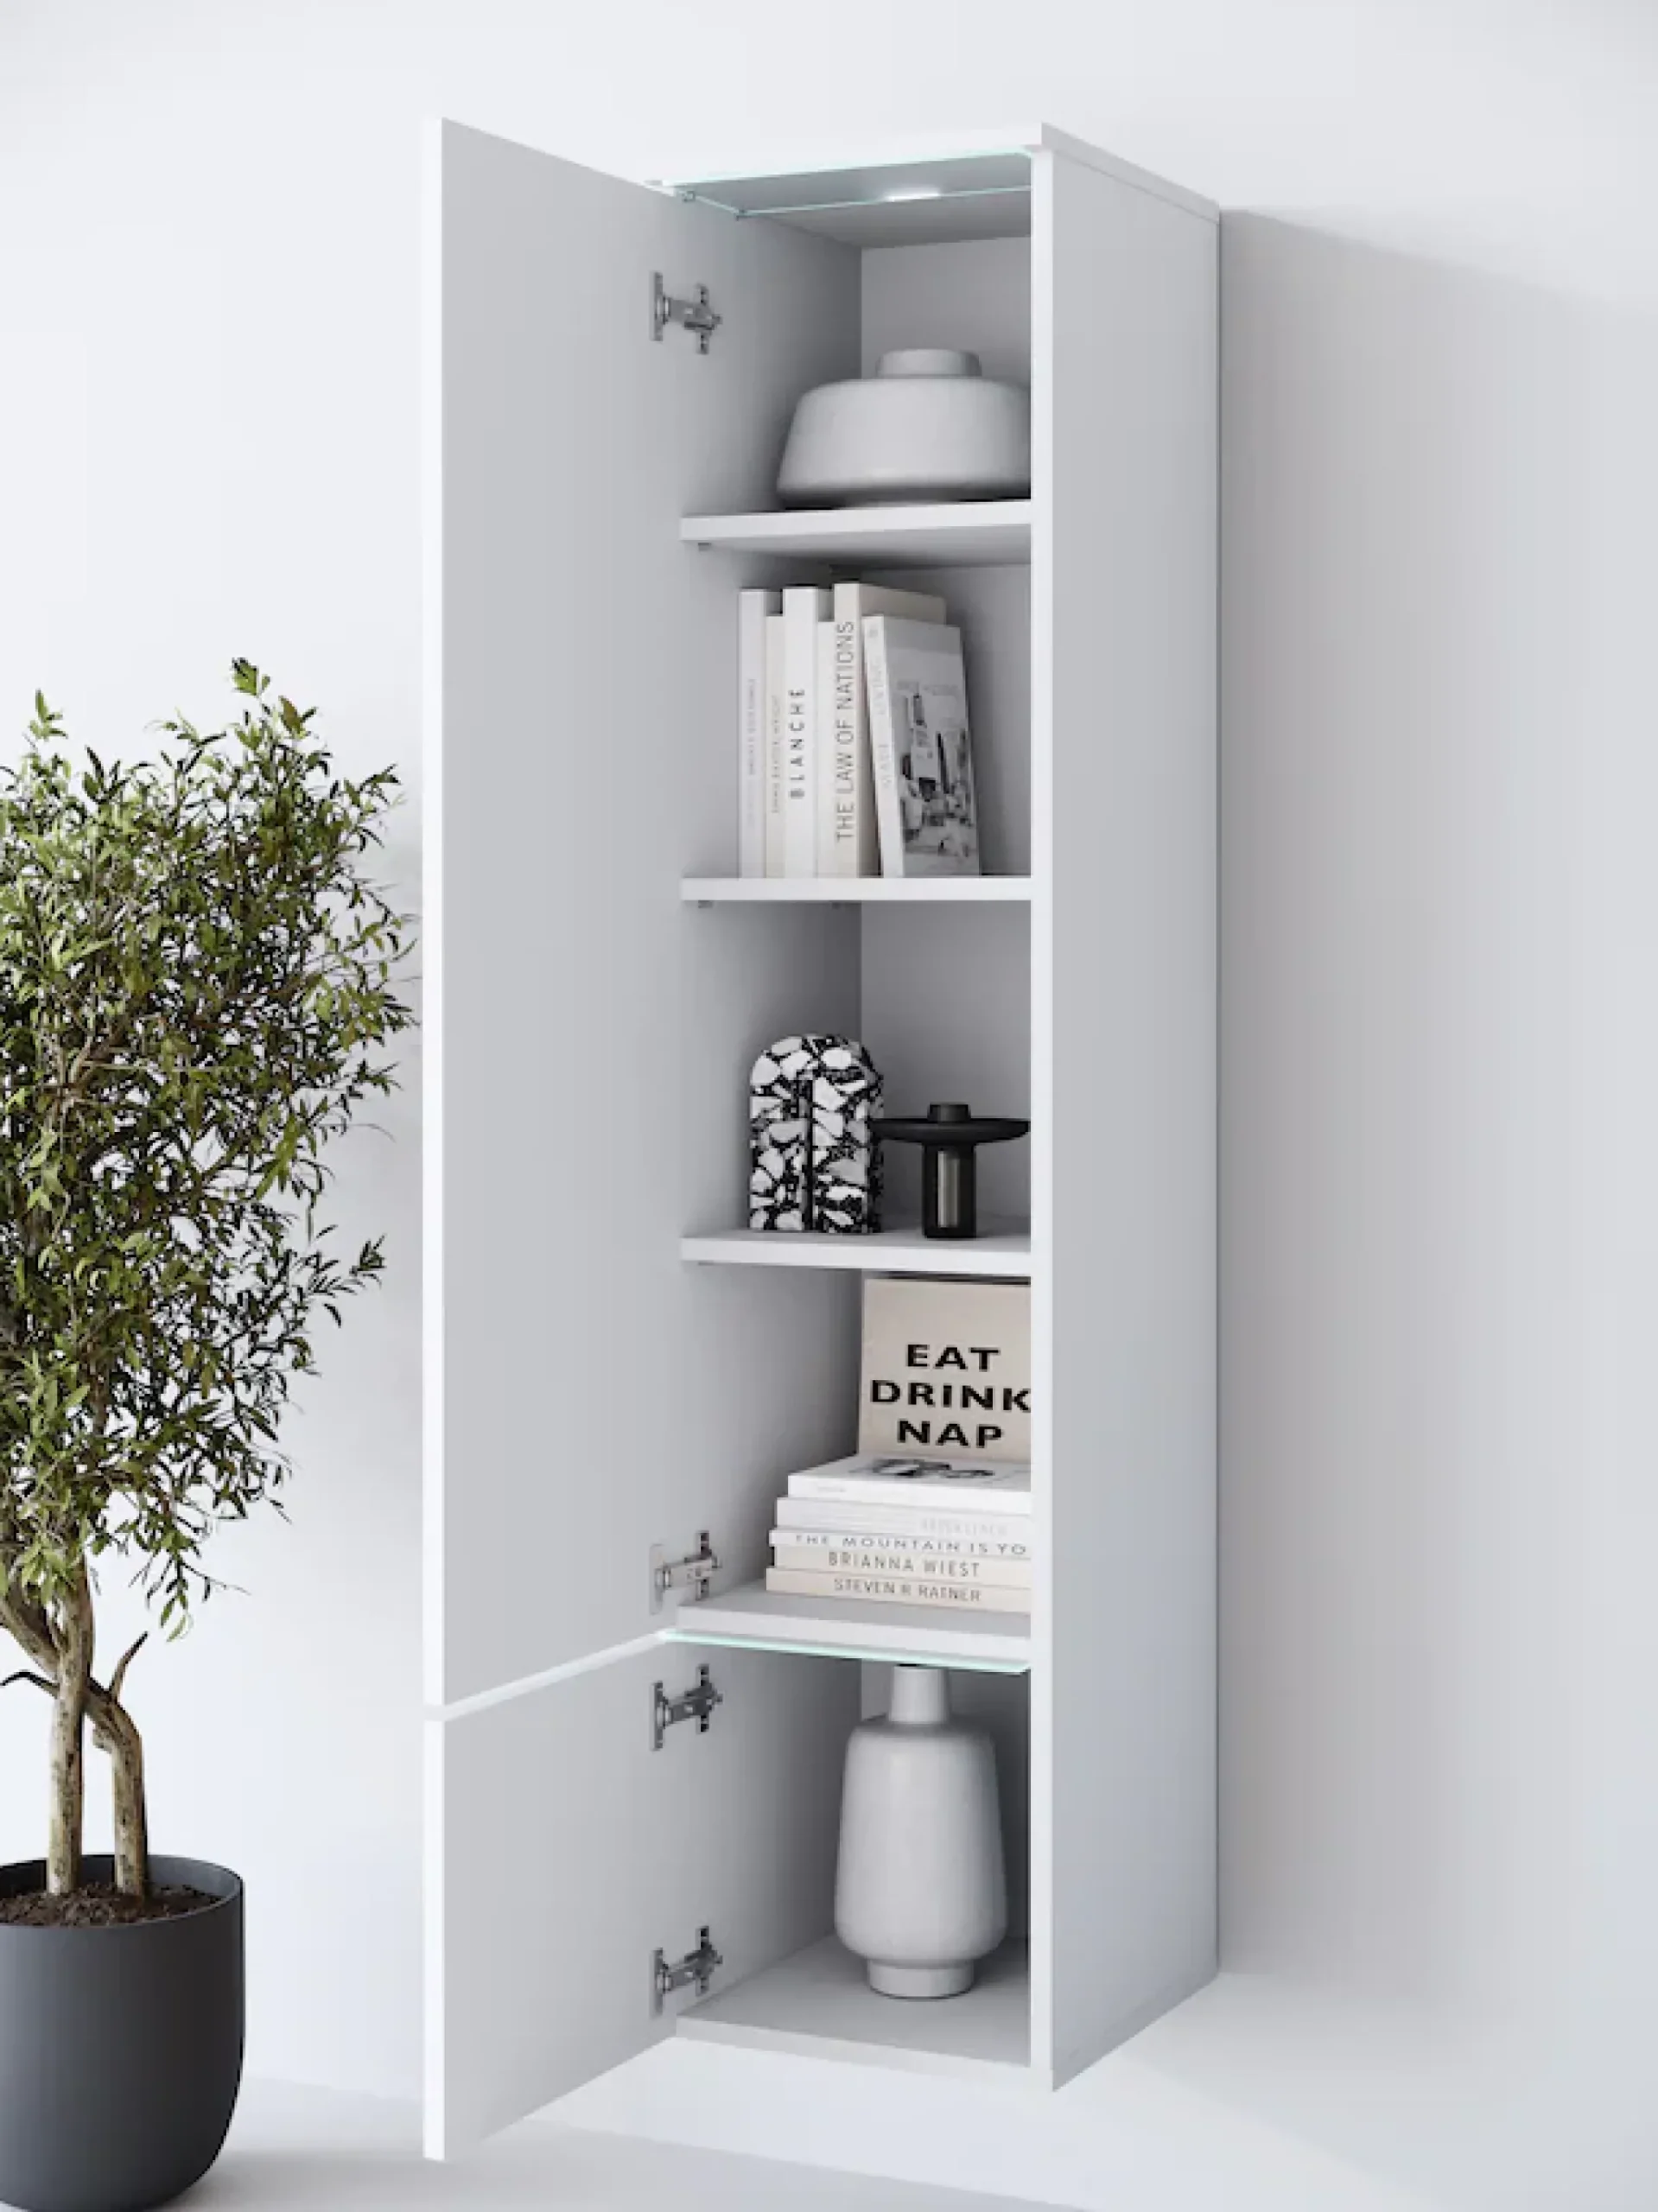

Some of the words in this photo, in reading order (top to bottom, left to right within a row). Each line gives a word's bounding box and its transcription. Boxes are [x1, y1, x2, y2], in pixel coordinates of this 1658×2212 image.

[835, 620, 855, 711] NATIONS
[787, 689, 805, 800] BLANCHE
[835, 720, 855, 746] OF
[835, 752, 855, 795] LAW
[835, 802, 855, 842] THE
[906, 1344, 1001, 1373] EAT
[870, 1379, 1032, 1414] DRINK
[897, 1419, 1005, 1449] NAP
[795, 1535, 828, 1546] THE
[842, 1536, 959, 1553] MOUNTAIN
[969, 1543, 988, 1554] IS
[828, 1551, 915, 1573] BRIANNA
[923, 1560, 981, 1578] WIEST
[834, 1578, 896, 1595] STEVEN
